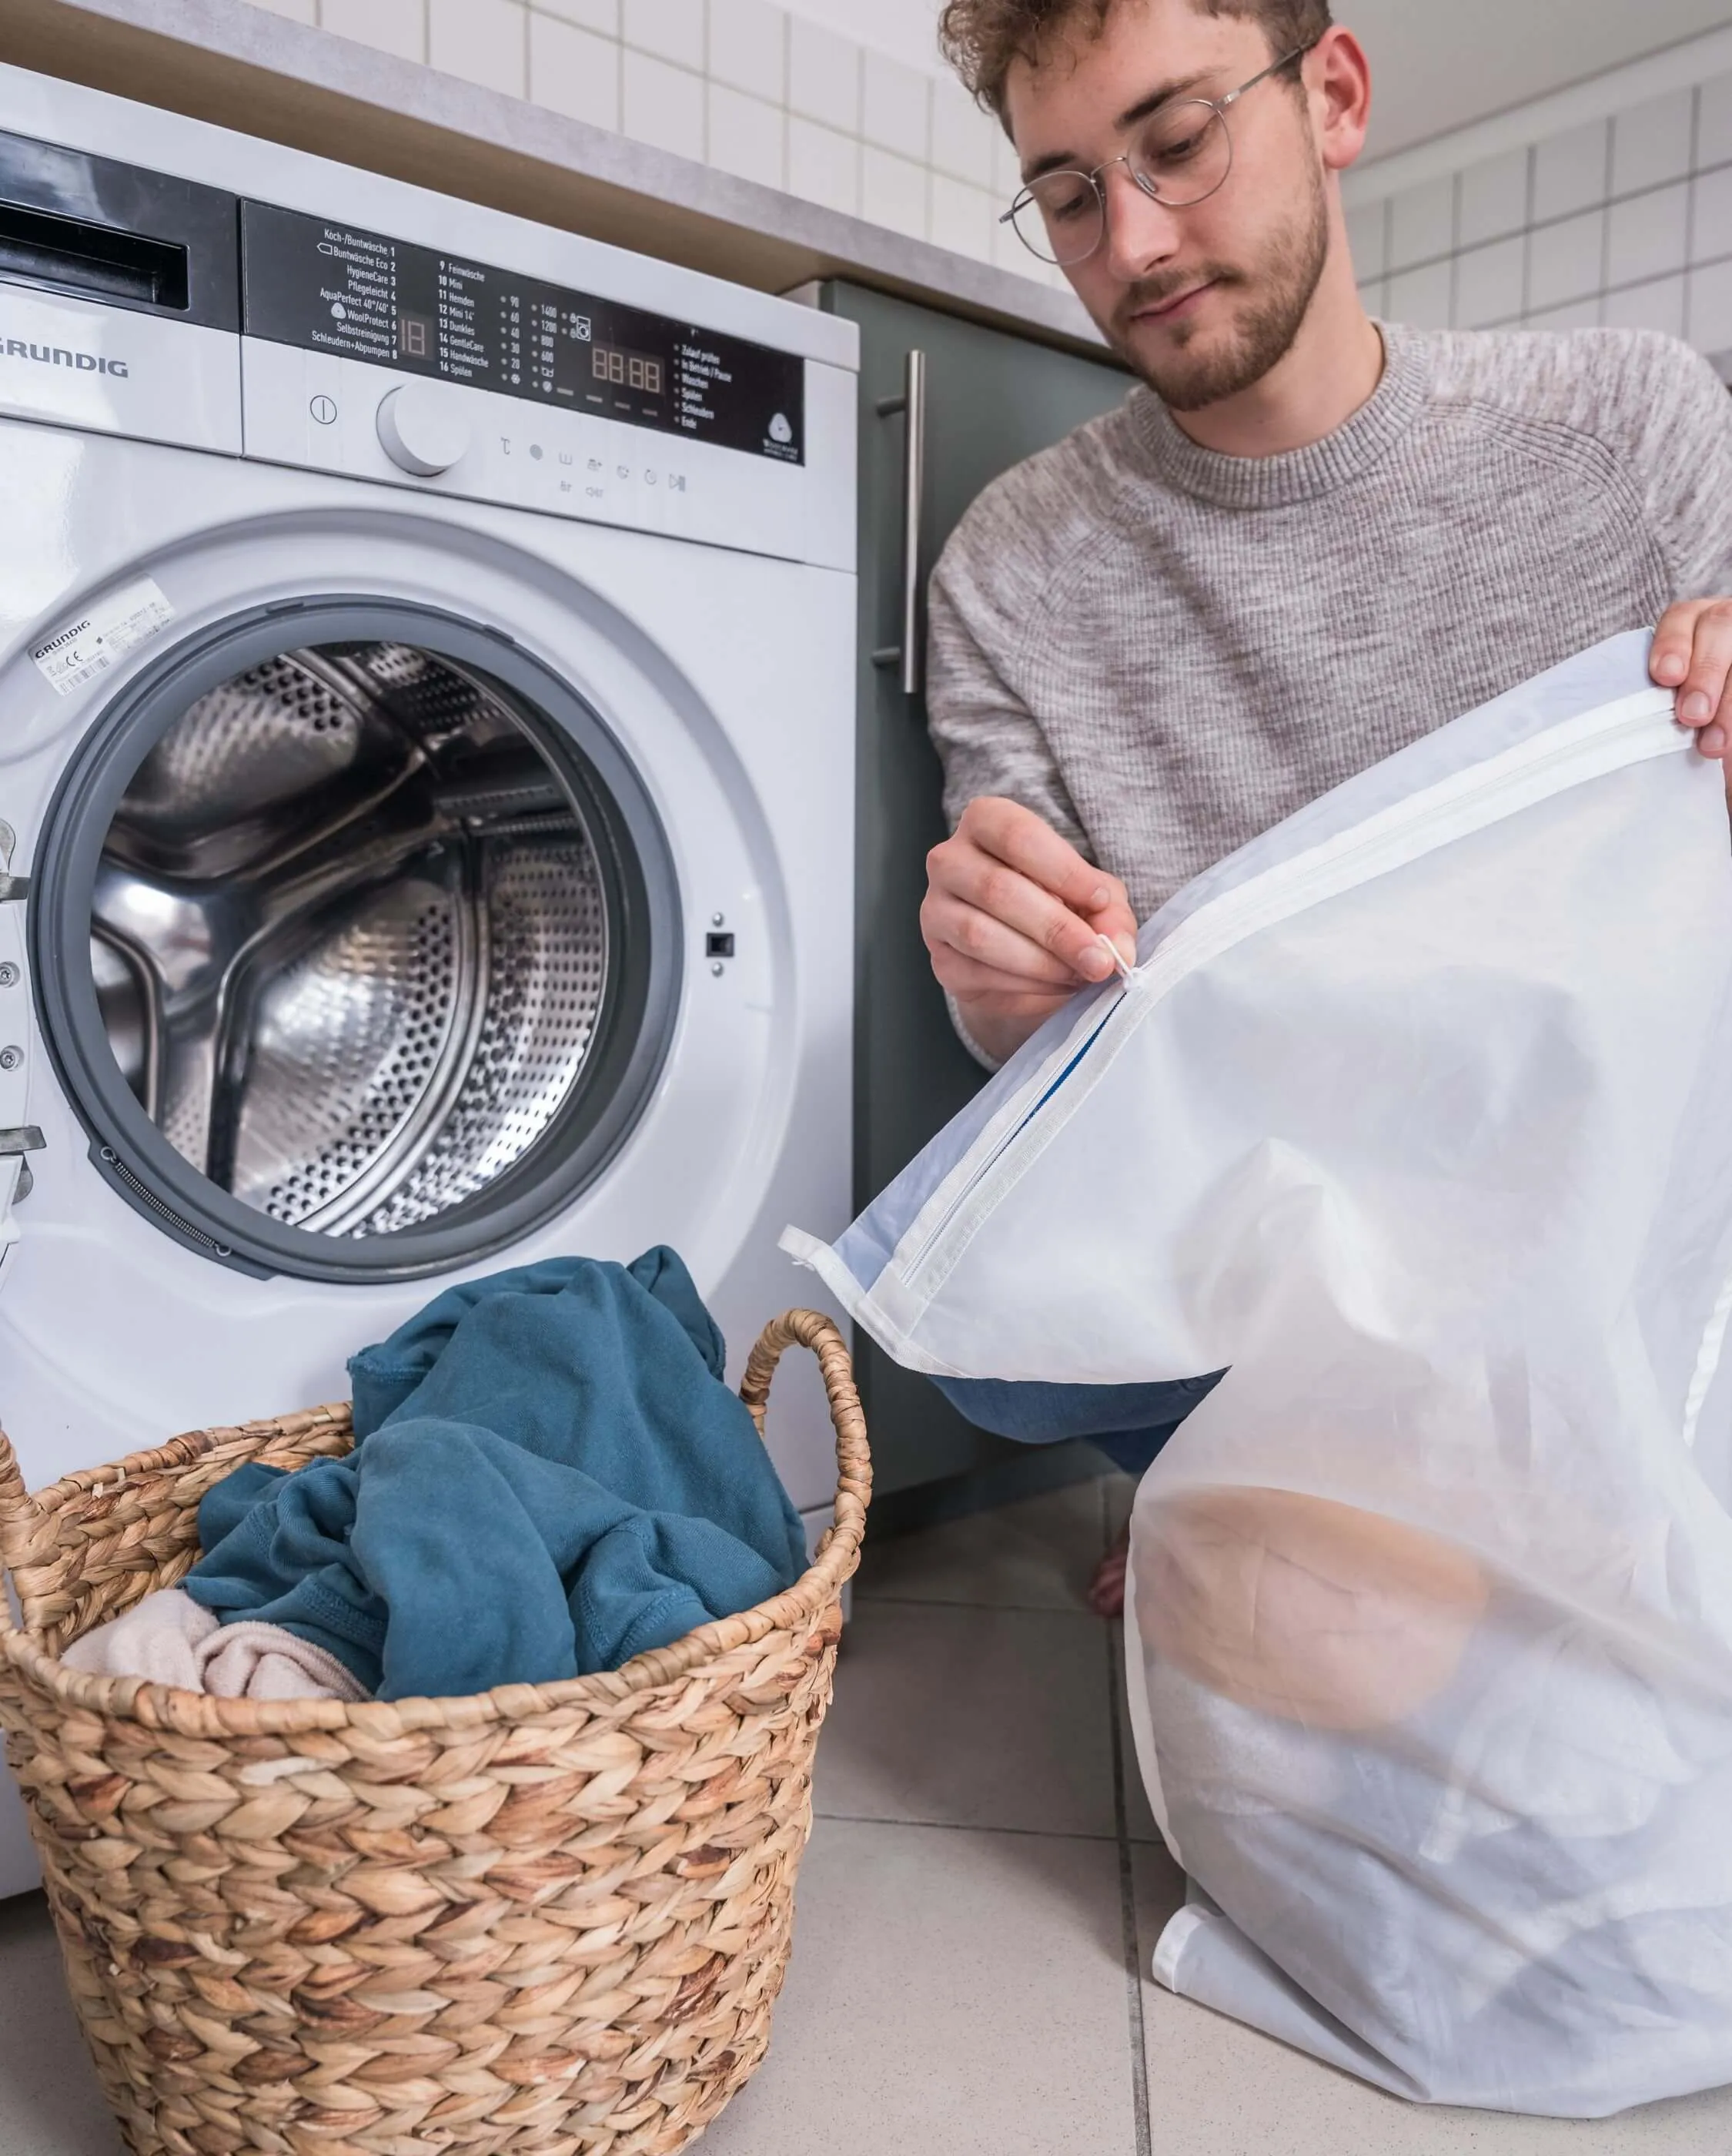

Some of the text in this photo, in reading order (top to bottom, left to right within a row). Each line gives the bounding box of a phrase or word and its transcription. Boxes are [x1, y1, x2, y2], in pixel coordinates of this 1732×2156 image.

[324, 229, 395, 256] Koch-/Buntwäsche 1
[333, 246, 395, 271] Buntwäsche Eco 2
[347, 265, 396, 286] HygieneCare 3
[440, 260, 485, 282] 9 Feinwäsche
[348, 280, 396, 300] Pflegeleicht 4
[438, 275, 463, 290] 10 Mini
[320, 288, 362, 306] AquaPerfect
[391, 306, 396, 315] 5
[439, 290, 474, 307] 11 Hemden
[510, 296, 520, 307] 90
[439, 304, 447, 314] 12
[449, 306, 463, 319] Mini
[510, 312, 520, 323] 60
[541, 304, 557, 318] 1400
[347, 310, 396, 330] WoolProtect 6
[439, 318, 475, 336] 13 Dunkles
[541, 320, 557, 333] 1200
[336, 323, 396, 345] Selbstreinigung 7
[511, 327, 520, 339] 40
[312, 331, 397, 359] Schleudern+Abpumpen 8
[440, 333, 484, 352] 14 GentleCare
[511, 343, 520, 354] 30
[541, 336, 553, 348] 800
[0, 336, 129, 378] RUNDIG
[440, 347, 489, 367] 15 Handwäsche
[511, 359, 520, 370] 20
[541, 351, 553, 363] 600
[440, 361, 473, 377] 16 Spülen
